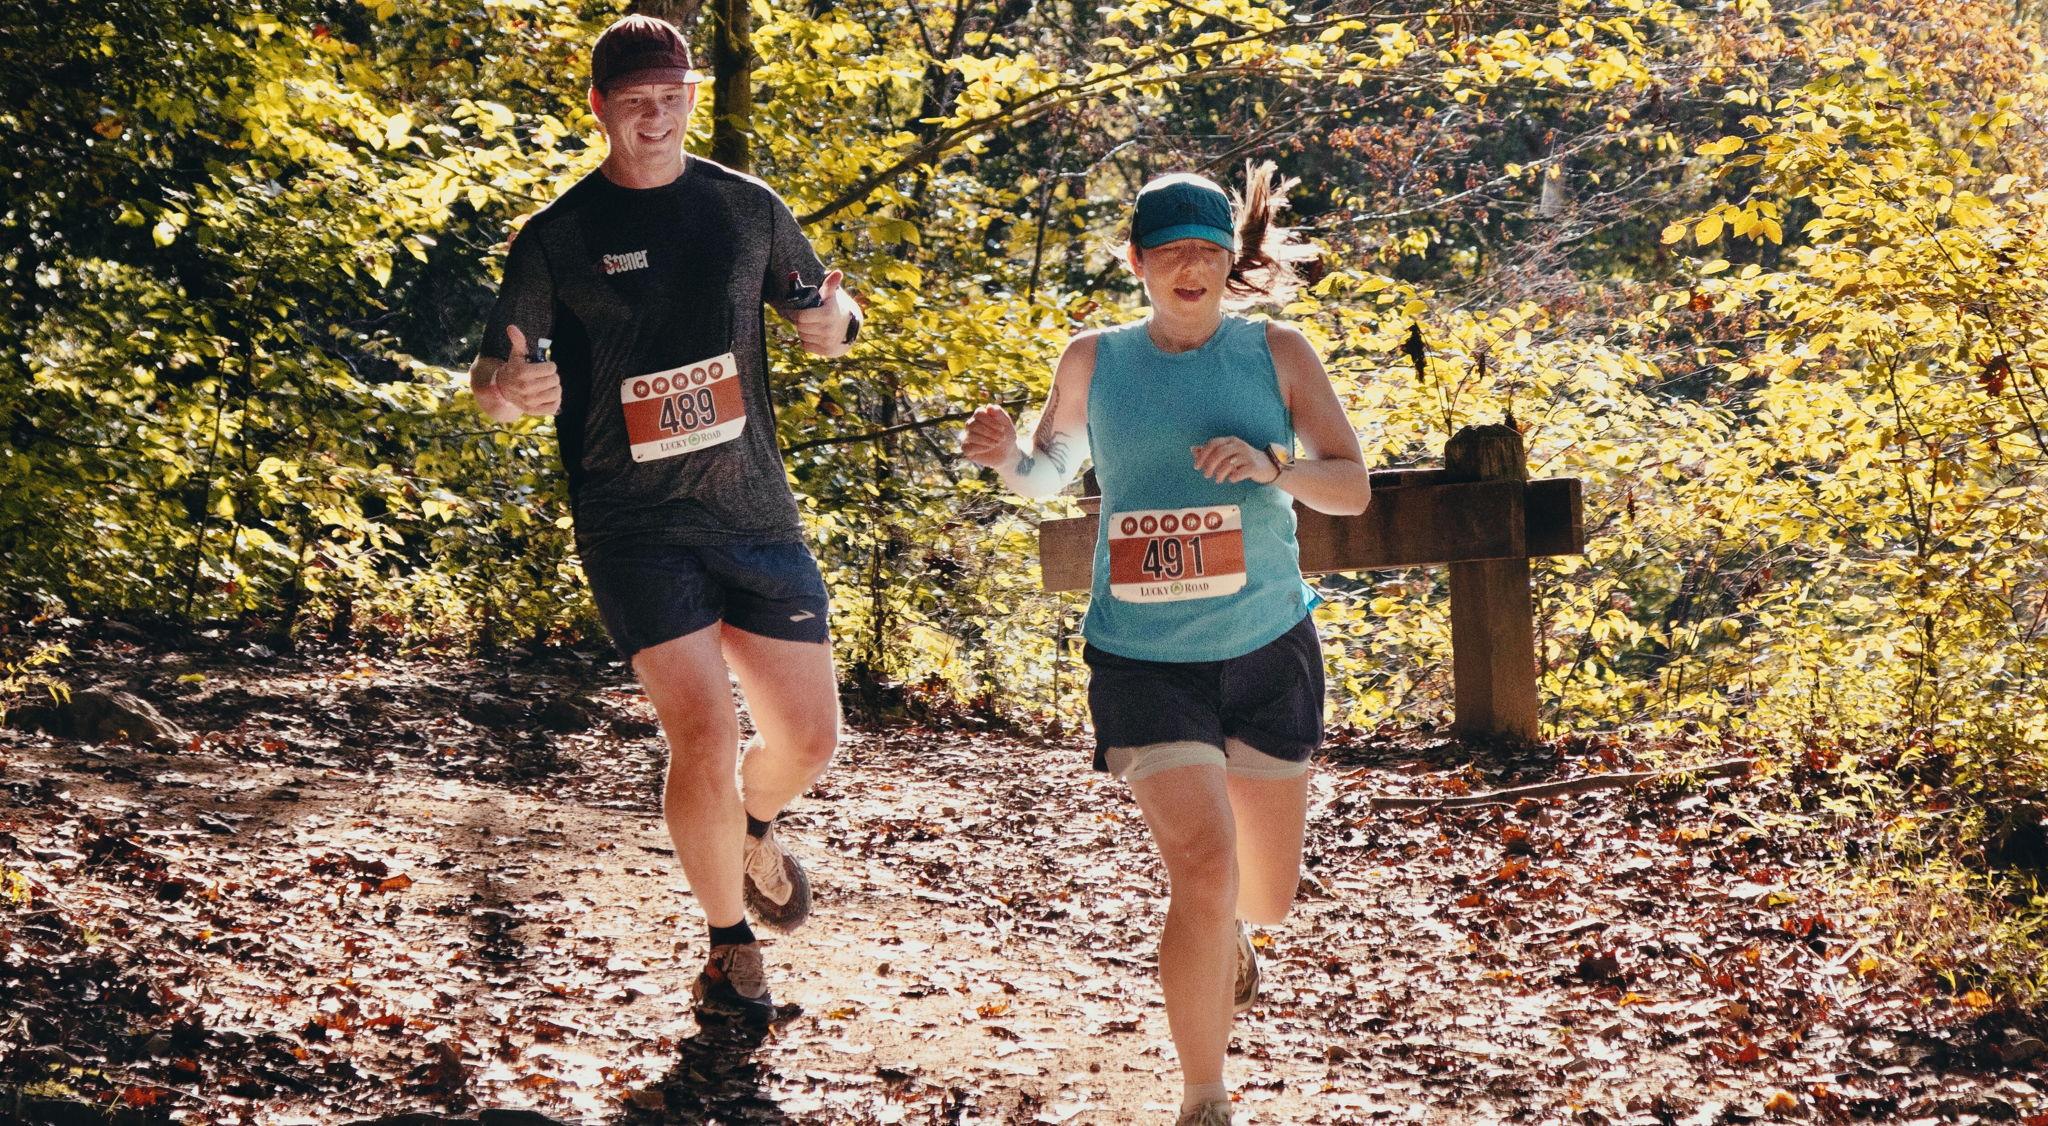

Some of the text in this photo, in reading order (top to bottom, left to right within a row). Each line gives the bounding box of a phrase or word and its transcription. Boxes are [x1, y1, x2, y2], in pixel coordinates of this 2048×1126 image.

[603, 250, 649, 274] Stoner
[659, 388, 716, 434] 489
[661, 430, 721, 452] LUCKY ROAD
[1143, 536, 1203, 580] 491
[1140, 583, 1209, 597] LUCKY ROAD
